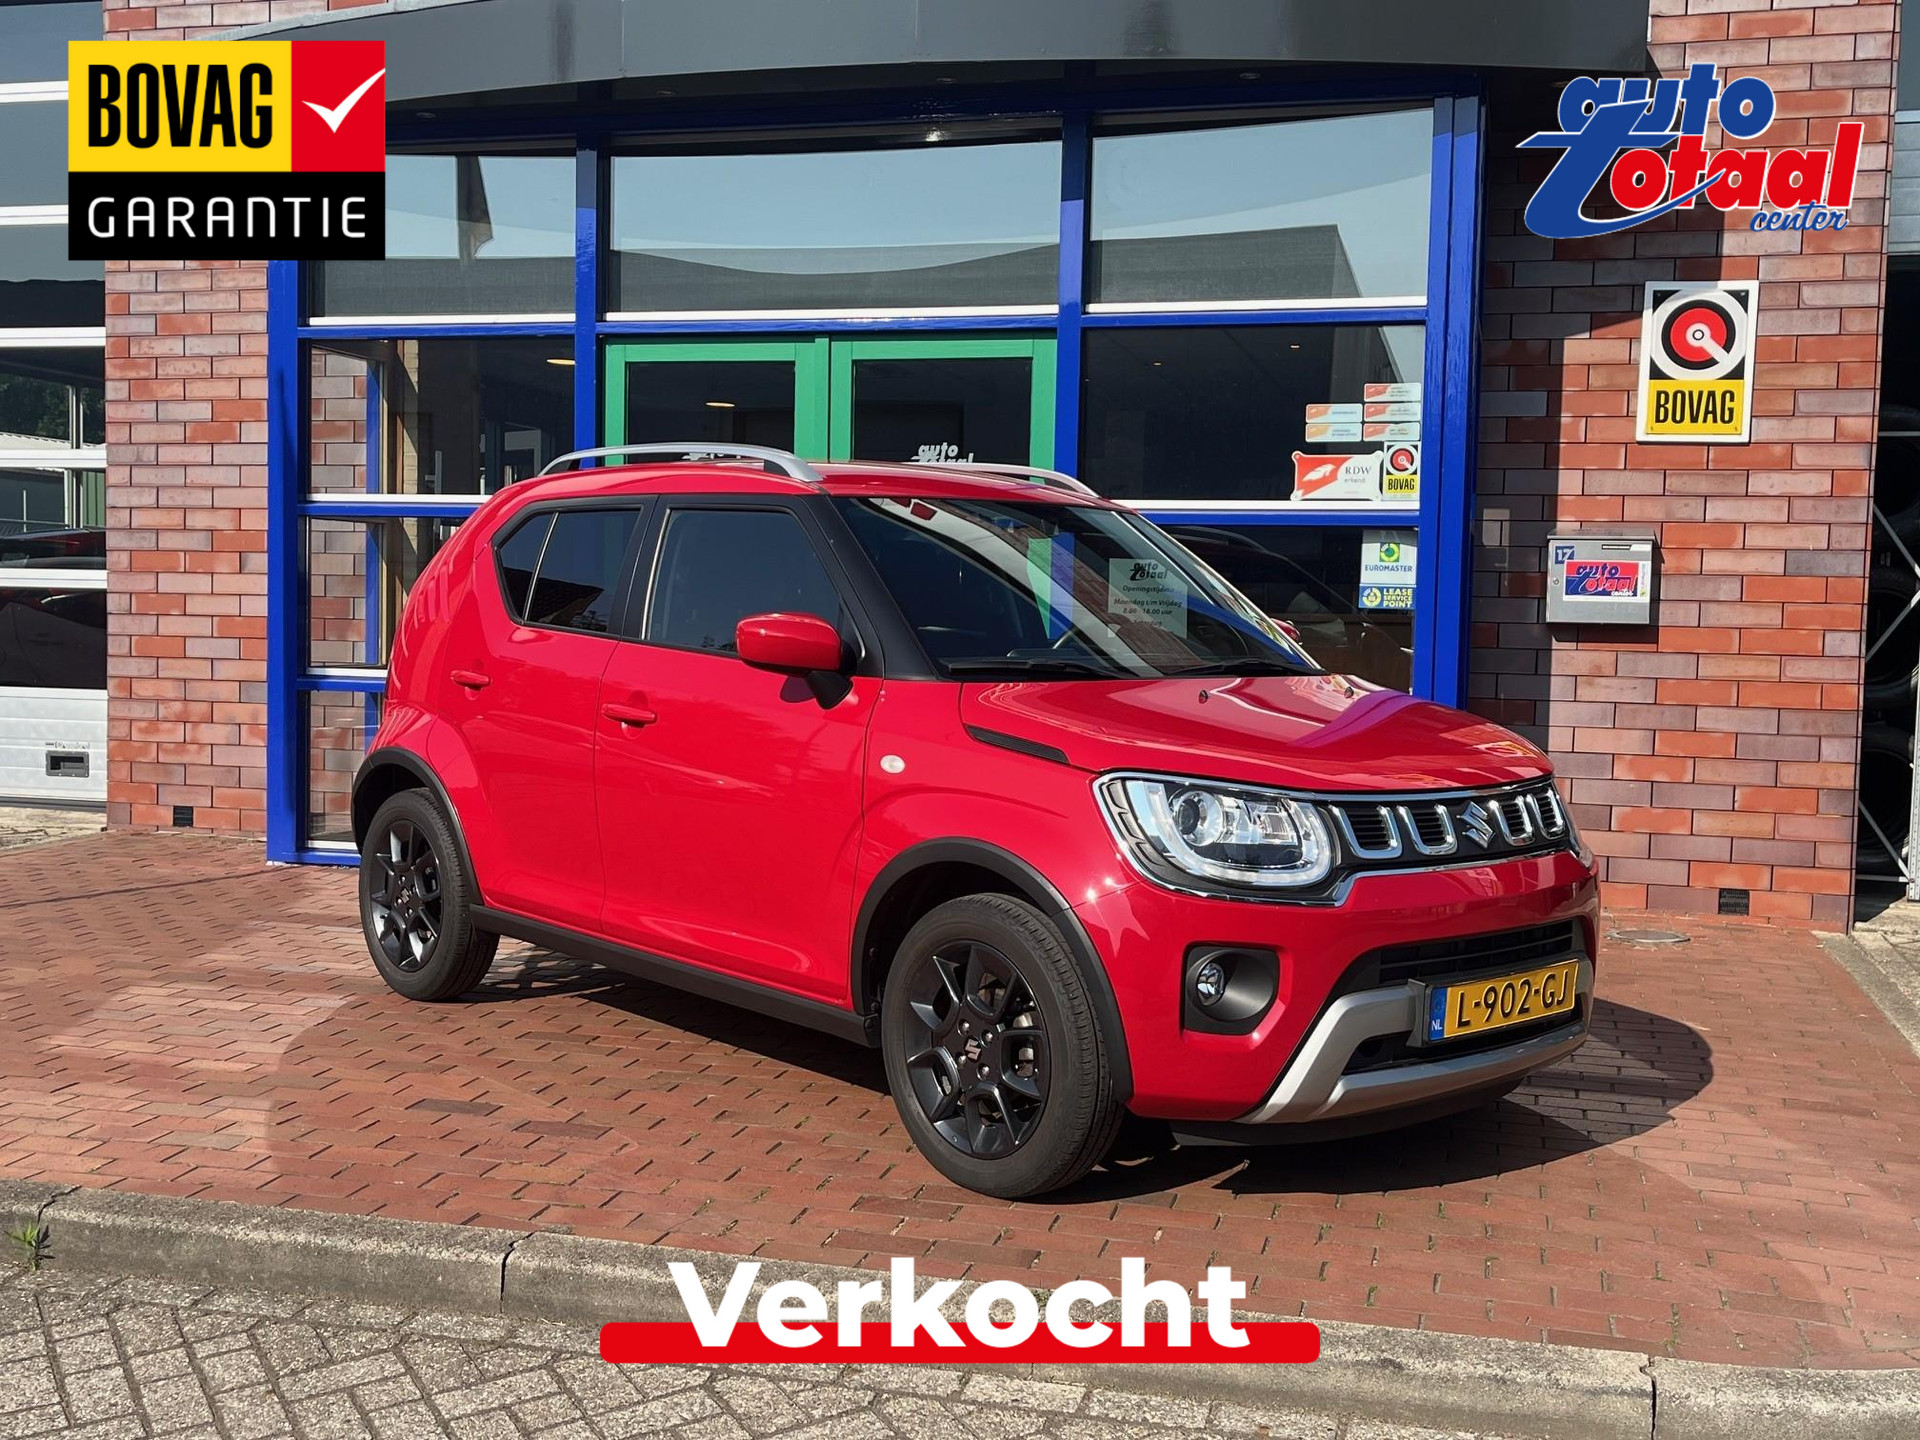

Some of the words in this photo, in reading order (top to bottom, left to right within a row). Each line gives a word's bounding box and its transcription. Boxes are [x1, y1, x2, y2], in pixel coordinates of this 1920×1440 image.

[1654, 389, 1735, 425] BOVAG
[1345, 466, 1371, 475] RDW
[1387, 478, 1415, 491] BOVAG
[1556, 548, 1575, 561] 17
[1575, 563, 1619, 577] auto
[1383, 600, 1412, 608] POINT
[1456, 969, 1568, 1028] L-902-GJ
[1431, 1019, 1443, 1030] NL
